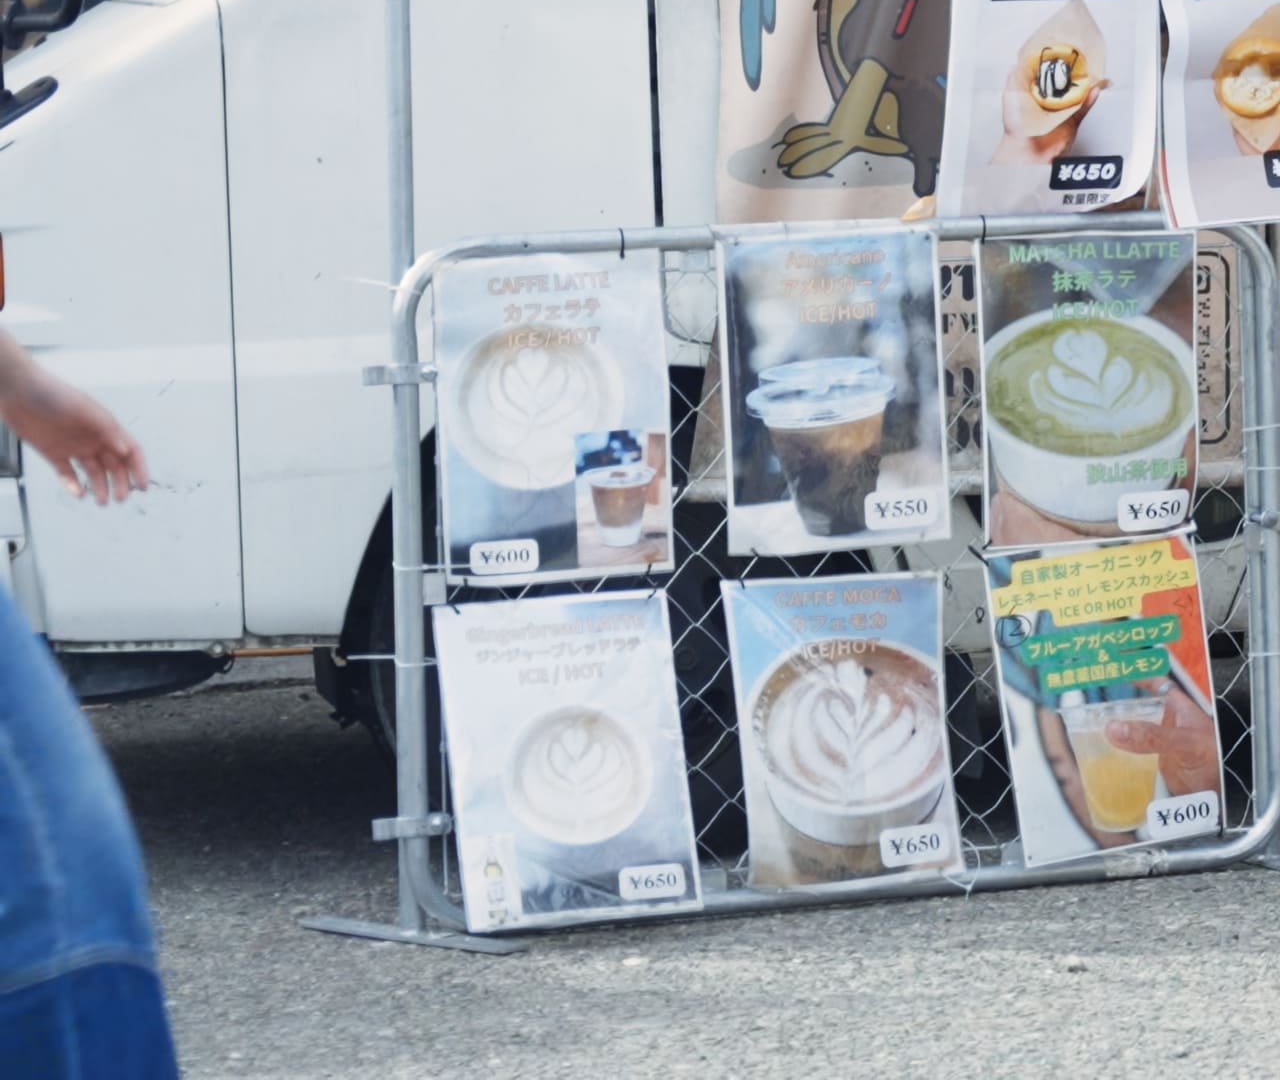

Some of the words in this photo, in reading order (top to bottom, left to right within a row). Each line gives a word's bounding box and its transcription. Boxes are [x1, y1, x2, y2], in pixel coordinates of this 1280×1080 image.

[1058, 163, 1116, 182] ¥650
[1008, 242, 1097, 264] MATCHA
[1103, 241, 1180, 260] LLATTE
[487, 274, 550, 296] CAFFE
[553, 271, 611, 292] LATTE
[1052, 270, 1137, 293] 抹茶ラテ
[503, 297, 601, 323] カフェラテ
[800, 300, 877, 325] ICE/HOT
[1052, 299, 1138, 321] ICE/HOT
[507, 330, 538, 349] ICE
[557, 326, 600, 345] HOT
[874, 498, 929, 519] ¥550
[1127, 499, 1181, 520] ¥650
[479, 547, 531, 565] ¥600
[1020, 548, 1164, 585] 自家製オーガニック
[774, 590, 836, 608] CAFFE
[843, 586, 902, 606] MOCA
[998, 587, 1062, 609] レモネード
[1068, 587, 1081, 598] or
[1086, 570, 1190, 594] レモンスカッシュ
[1059, 604, 1080, 618] ICE
[1083, 601, 1103, 615] OR
[1107, 596, 1134, 611] HOT
[802, 638, 877, 660] ICE/HOT
[1028, 621, 1175, 659] ブルーアガベシロップ
[1098, 649, 1110, 662] &
[1046, 656, 1164, 688] 無農薬国産レモン
[1156, 801, 1211, 827] ¥600
[888, 833, 941, 854] ¥650
[629, 871, 678, 890] ¥650
